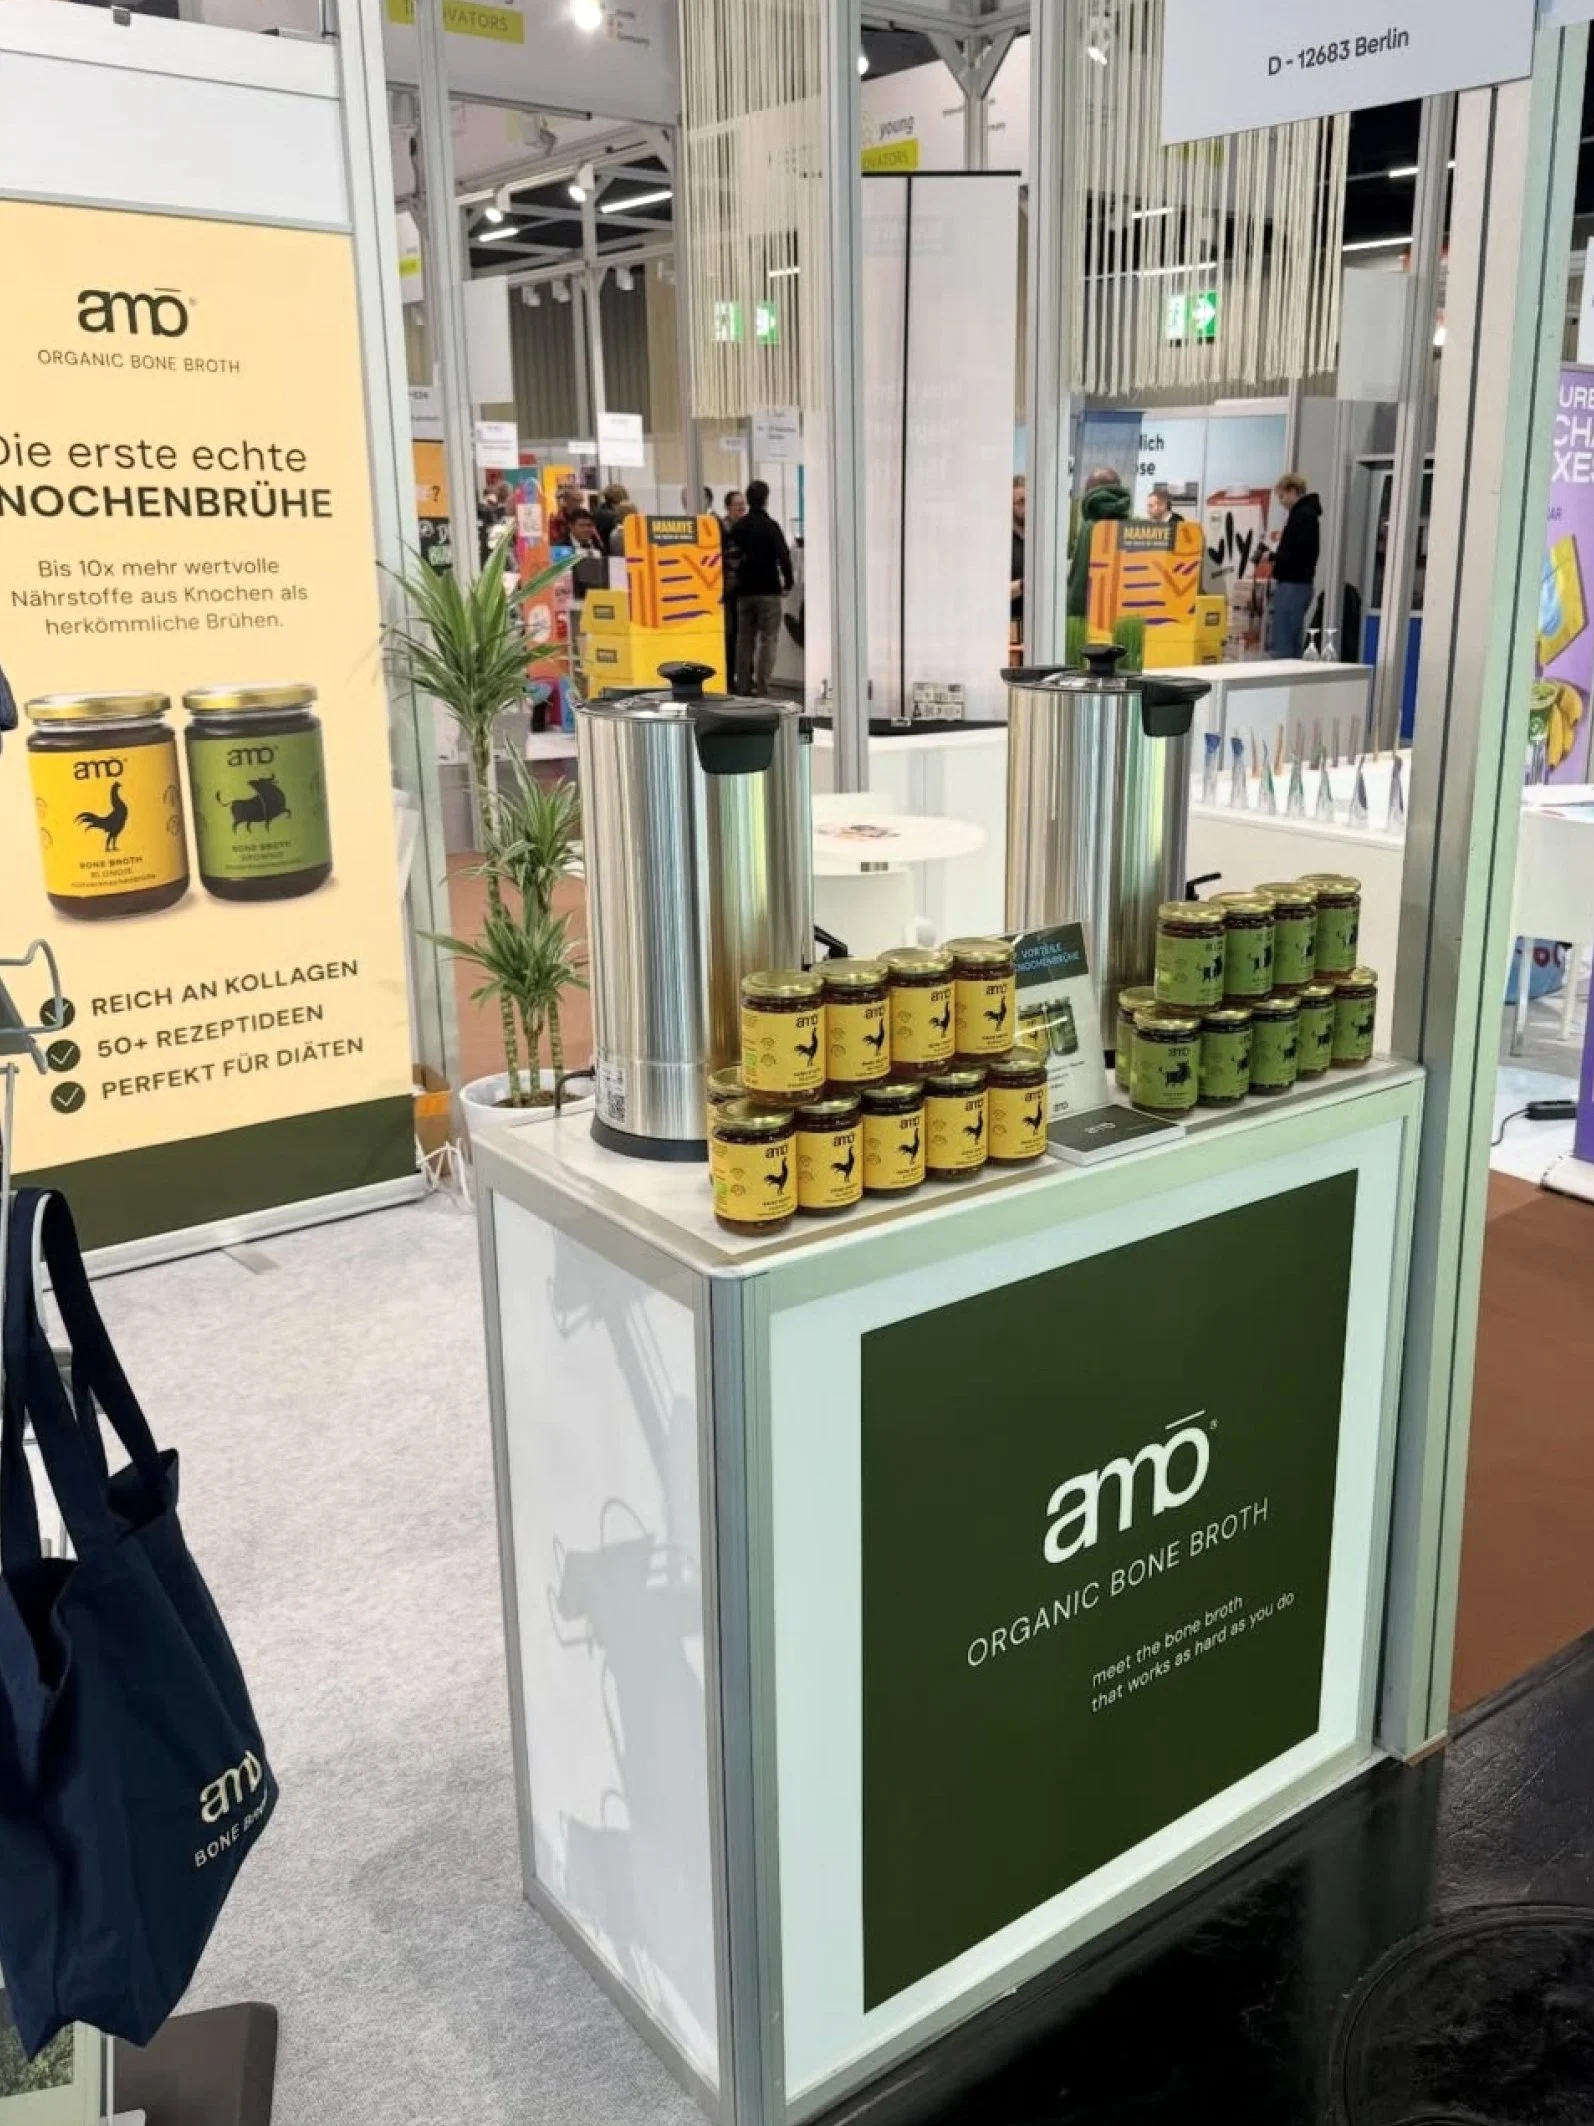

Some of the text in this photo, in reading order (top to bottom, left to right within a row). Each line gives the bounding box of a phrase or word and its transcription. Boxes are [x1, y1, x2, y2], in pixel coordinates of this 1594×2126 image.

[1268, 56, 1282, 76] D
[1298, 40, 1350, 69] 12683
[1354, 28, 1409, 57] Berlin
[37, 350, 240, 373] ORGANIC BONE BROTH
[68, 440, 177, 471] erste
[192, 441, 307, 473] echte
[38, 557, 280, 577] Bis 10x mehr wertvolle
[11, 584, 309, 607] Nährstoffe aus Knochen als
[45, 612, 285, 635] herkömmliche Brühen.
[109, 856, 143, 867] BROTH
[91, 959, 359, 1017] REICH AN KOLLAGEN
[97, 1003, 326, 1059] 50+ REZEPTIDEEN
[101, 1036, 365, 1100] PERFEKT FÜR DIÄTEN
[967, 1497, 1268, 1667] ORGANIC BONE BROTH
[1091, 1591, 1294, 1712] that works as hard as you do
[1092, 1595, 1243, 1688] meet the bone broth
[194, 1823, 239, 1868] BONE
